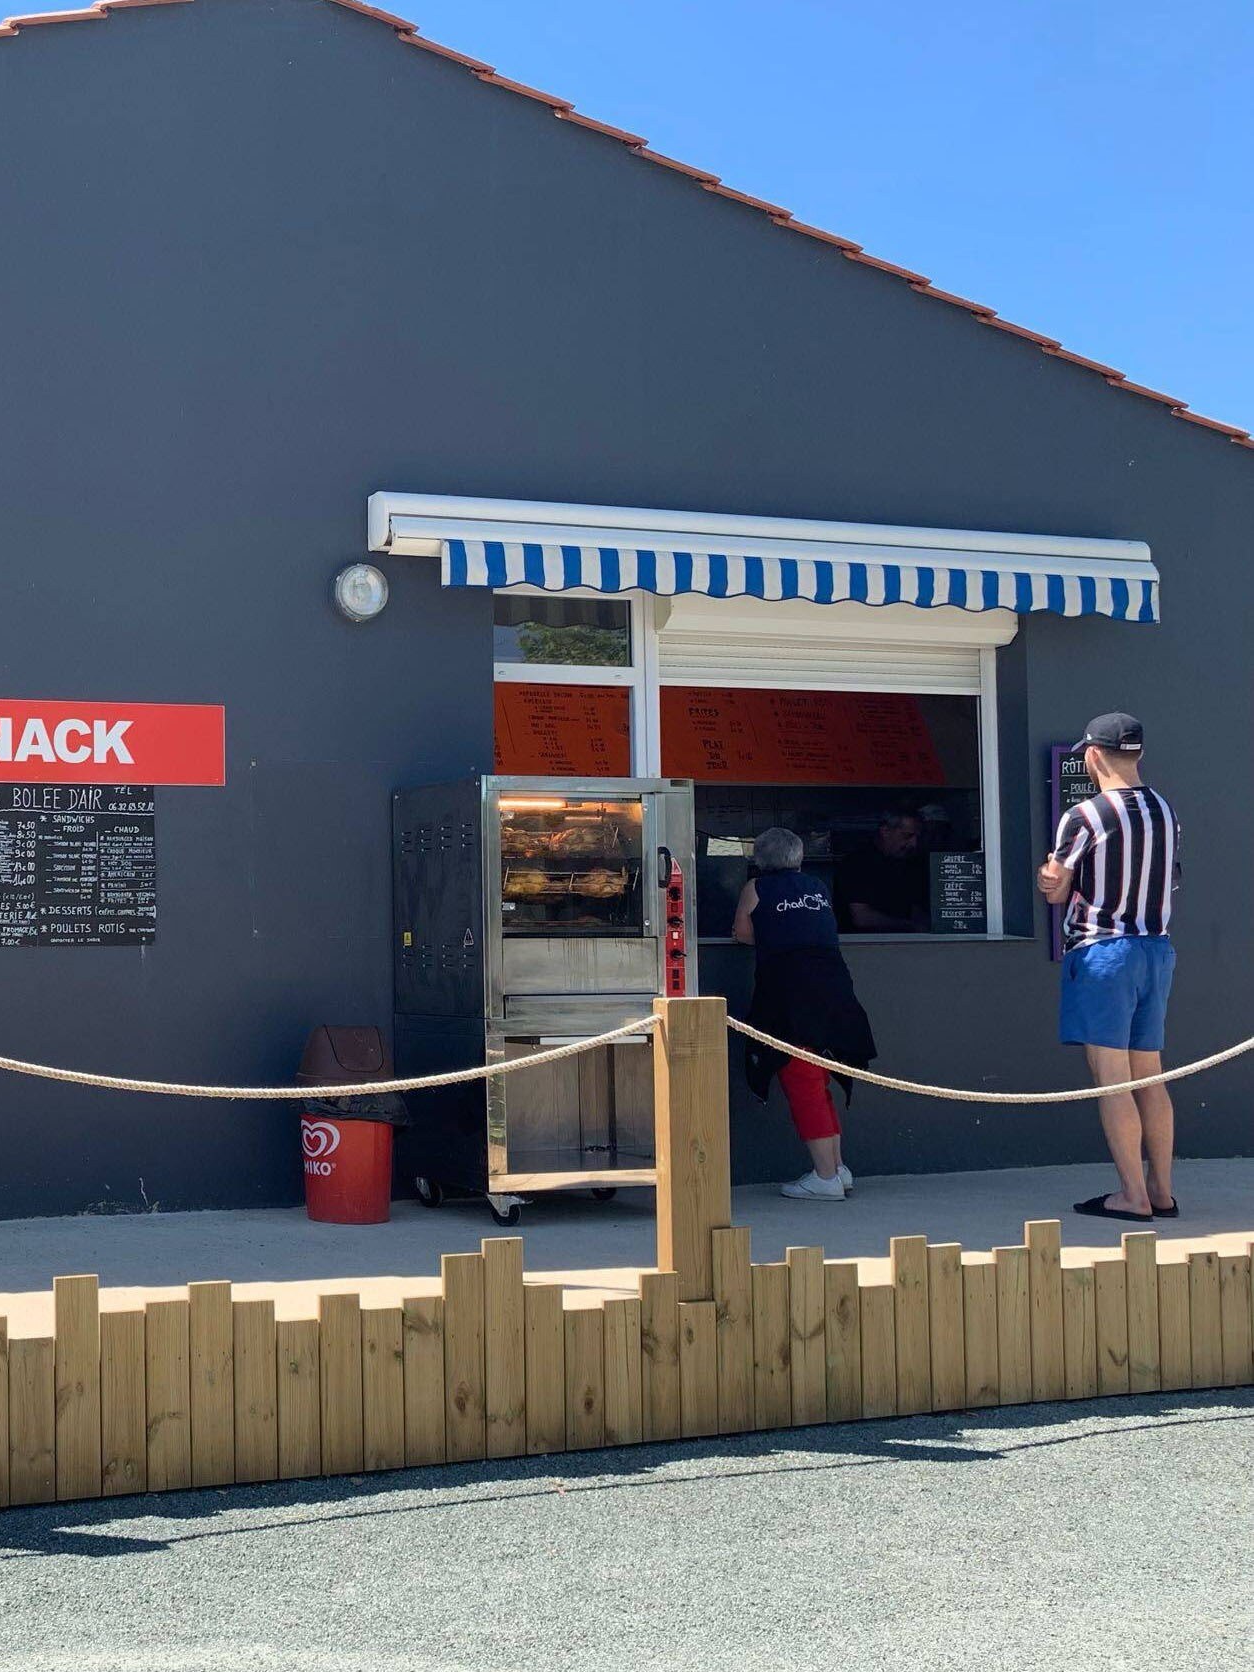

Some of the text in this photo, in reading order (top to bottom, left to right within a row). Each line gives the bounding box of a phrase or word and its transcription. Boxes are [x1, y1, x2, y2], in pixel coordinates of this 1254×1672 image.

[702, 739, 723, 749] PLAT
[1062, 757, 1088, 774] RÔTI
[52, 815, 95, 824] SANDWICHS
[62, 825, 85, 833] FROID
[113, 826, 140, 834] CHAUD
[48, 906, 92, 915] DESSERTS
[50, 923, 92, 933] POULETS
[98, 923, 125, 934] ROTIS
